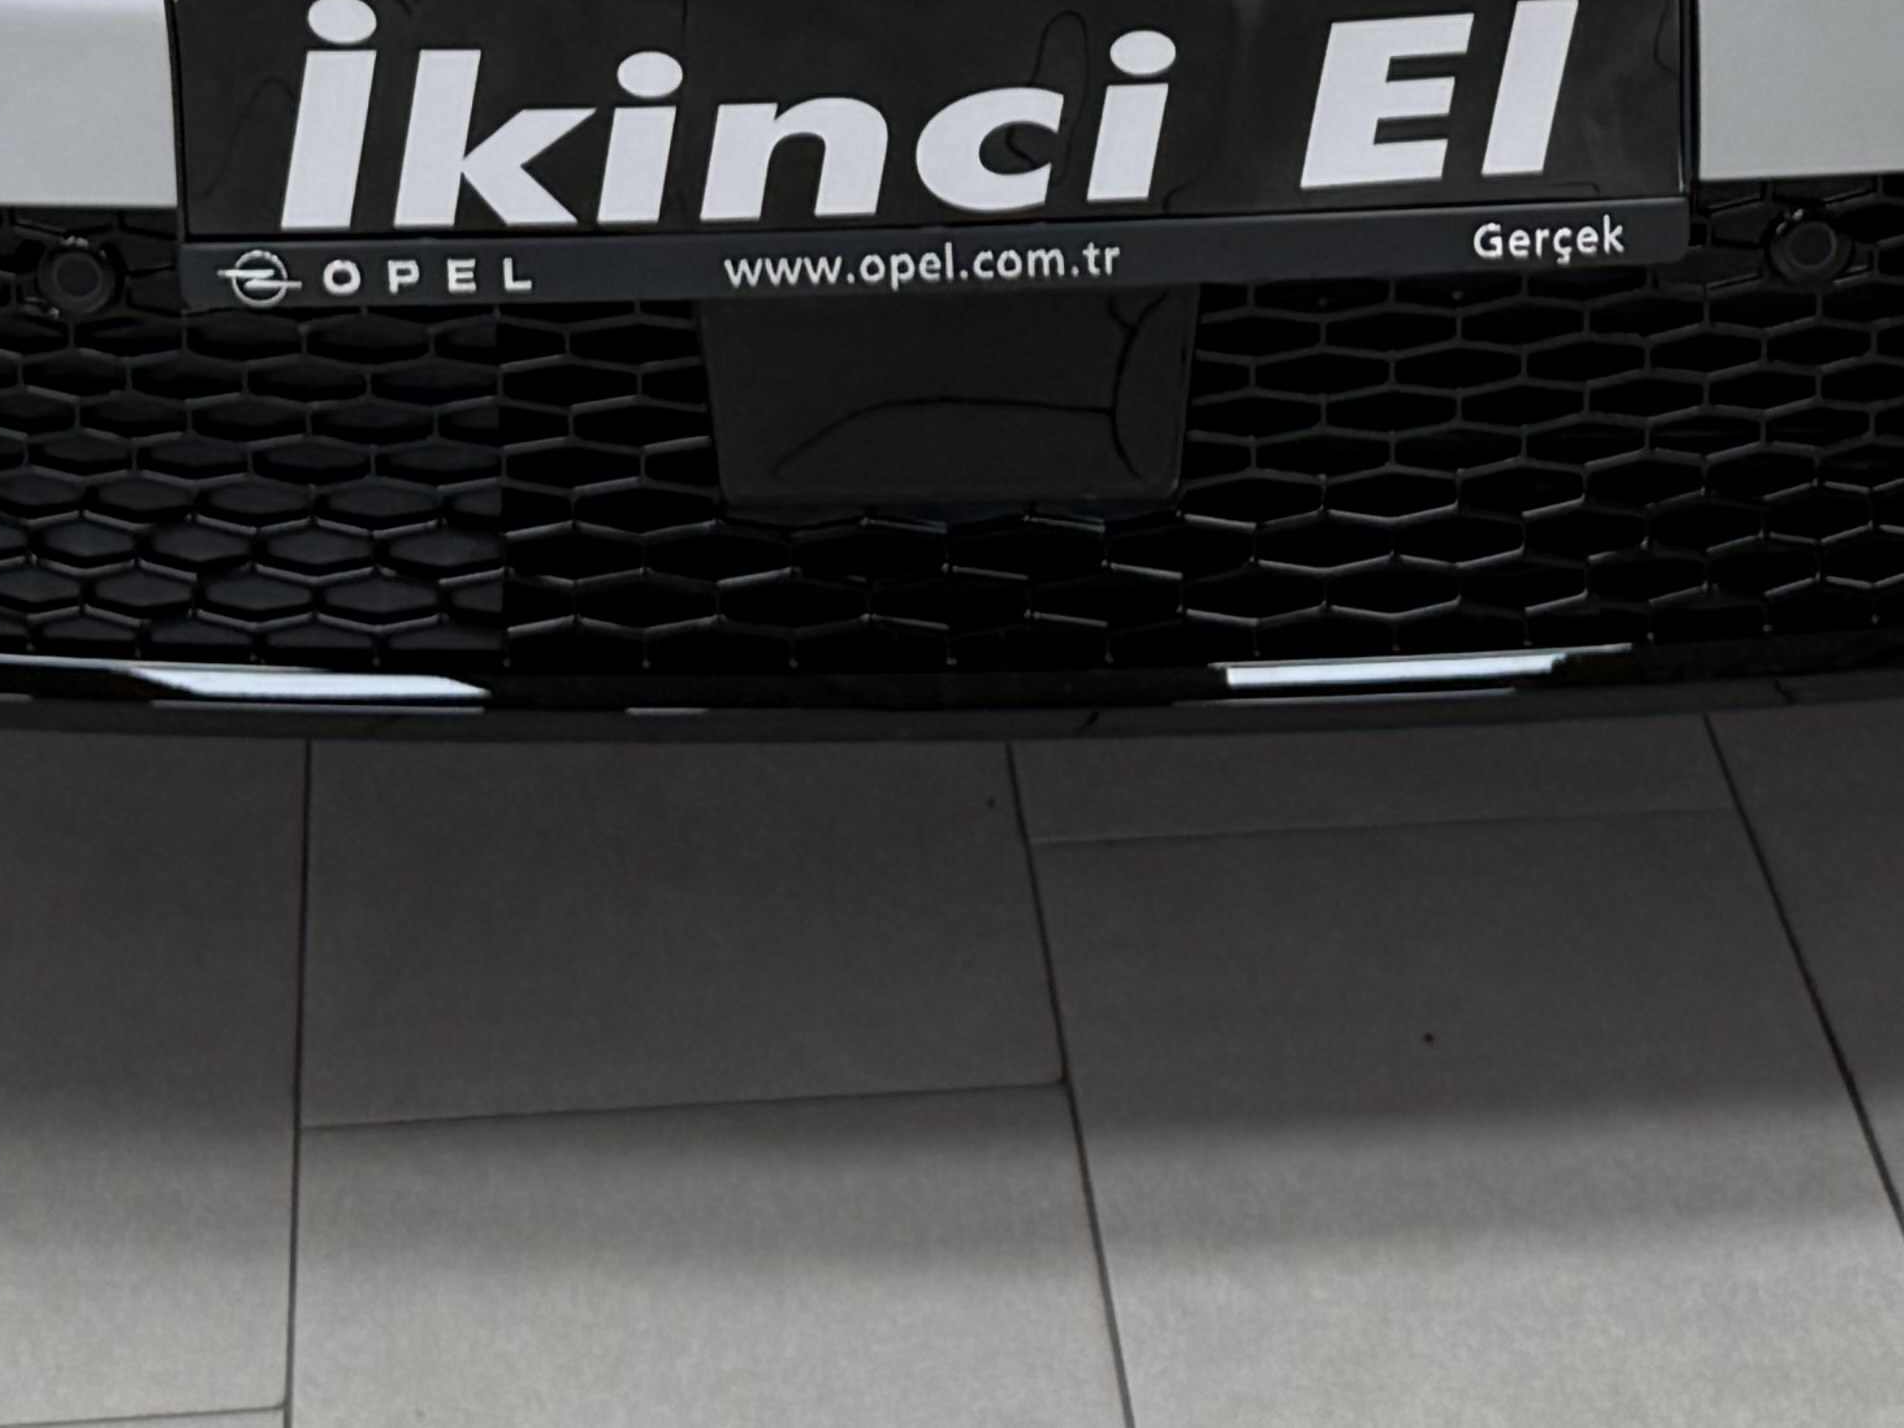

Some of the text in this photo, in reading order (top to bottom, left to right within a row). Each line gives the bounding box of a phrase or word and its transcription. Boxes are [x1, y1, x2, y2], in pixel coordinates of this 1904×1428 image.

[1472, 213, 1626, 266] Gerçek
[322, 256, 534, 296] OPEL
[722, 241, 1122, 291] www.opel.com.tr
